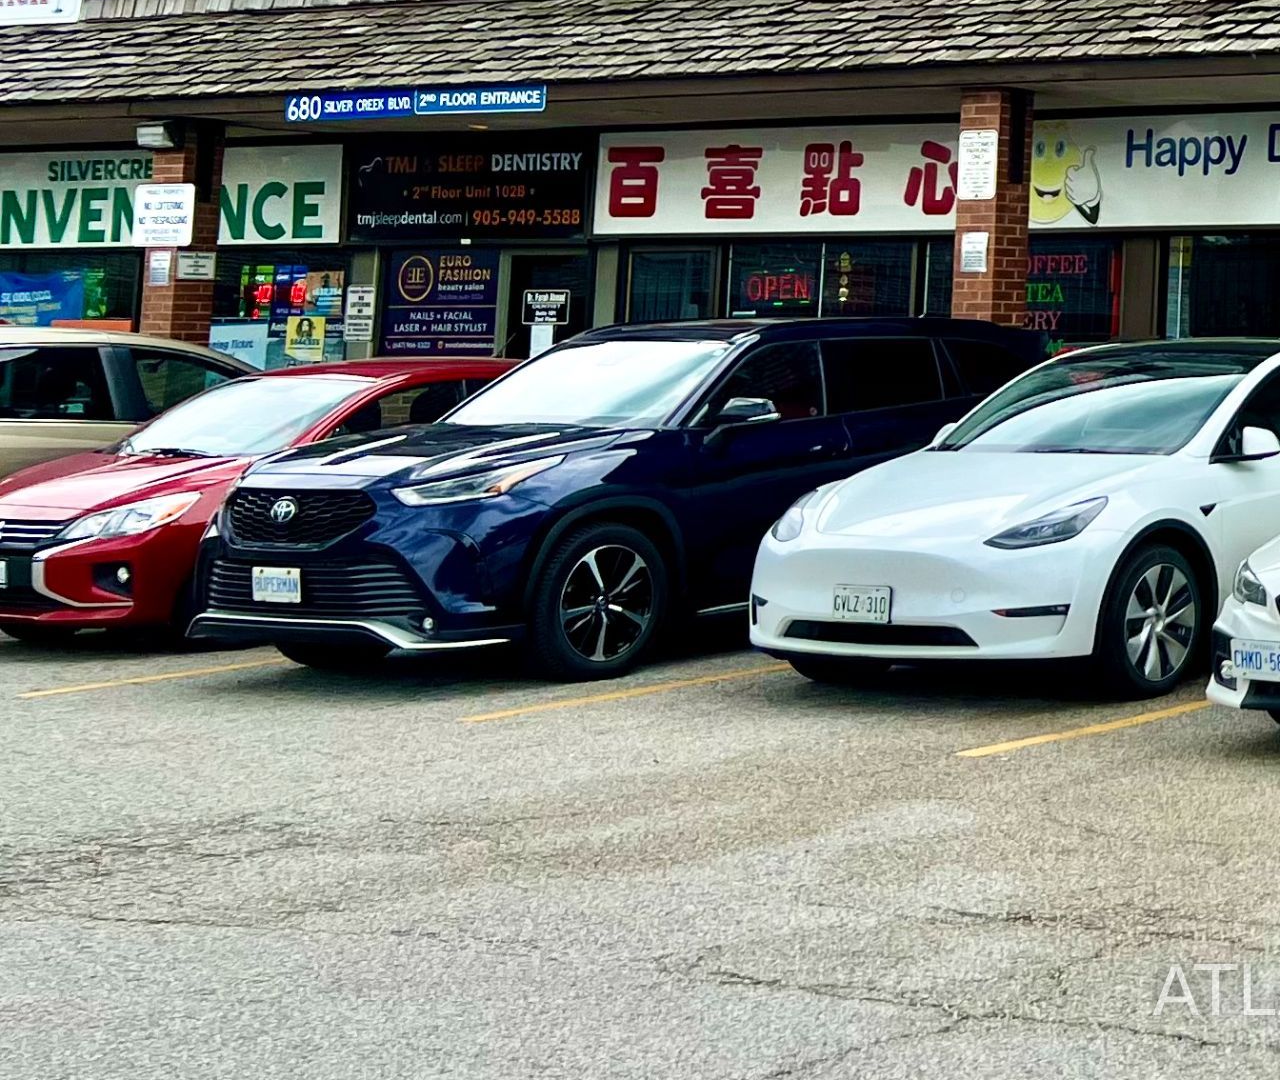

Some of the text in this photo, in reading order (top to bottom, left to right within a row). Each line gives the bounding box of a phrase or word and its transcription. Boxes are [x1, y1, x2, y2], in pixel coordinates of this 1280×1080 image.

[419, 90, 541, 107] 2ND FLOOR ENTRANCE
[288, 96, 322, 120] 680
[324, 101, 353, 113] SILVER
[356, 98, 384, 112] CREEK
[1125, 128, 1247, 176] Happy
[385, 156, 417, 174] TMJ
[438, 155, 484, 173] SLEEP
[490, 152, 583, 172] DENTISTRY
[608, 140, 957, 219] 百喜點心
[431, 184, 460, 198] Floor
[465, 184, 490, 198] Unit
[357, 209, 581, 228] tmjsleepdental.com 905-949-5588
[439, 255, 472, 267] EURO
[438, 269, 491, 281] FASHION
[438, 283, 484, 293] beauty salon
[746, 274, 811, 301] OPEN
[1025, 283, 1064, 302] TEA
[409, 311, 472, 320] NAILS FACIAL
[394, 323, 487, 332] LASER HAIR STYLIST
[867, 596, 886, 614] 310
[1234, 650, 1262, 670] CHKD
